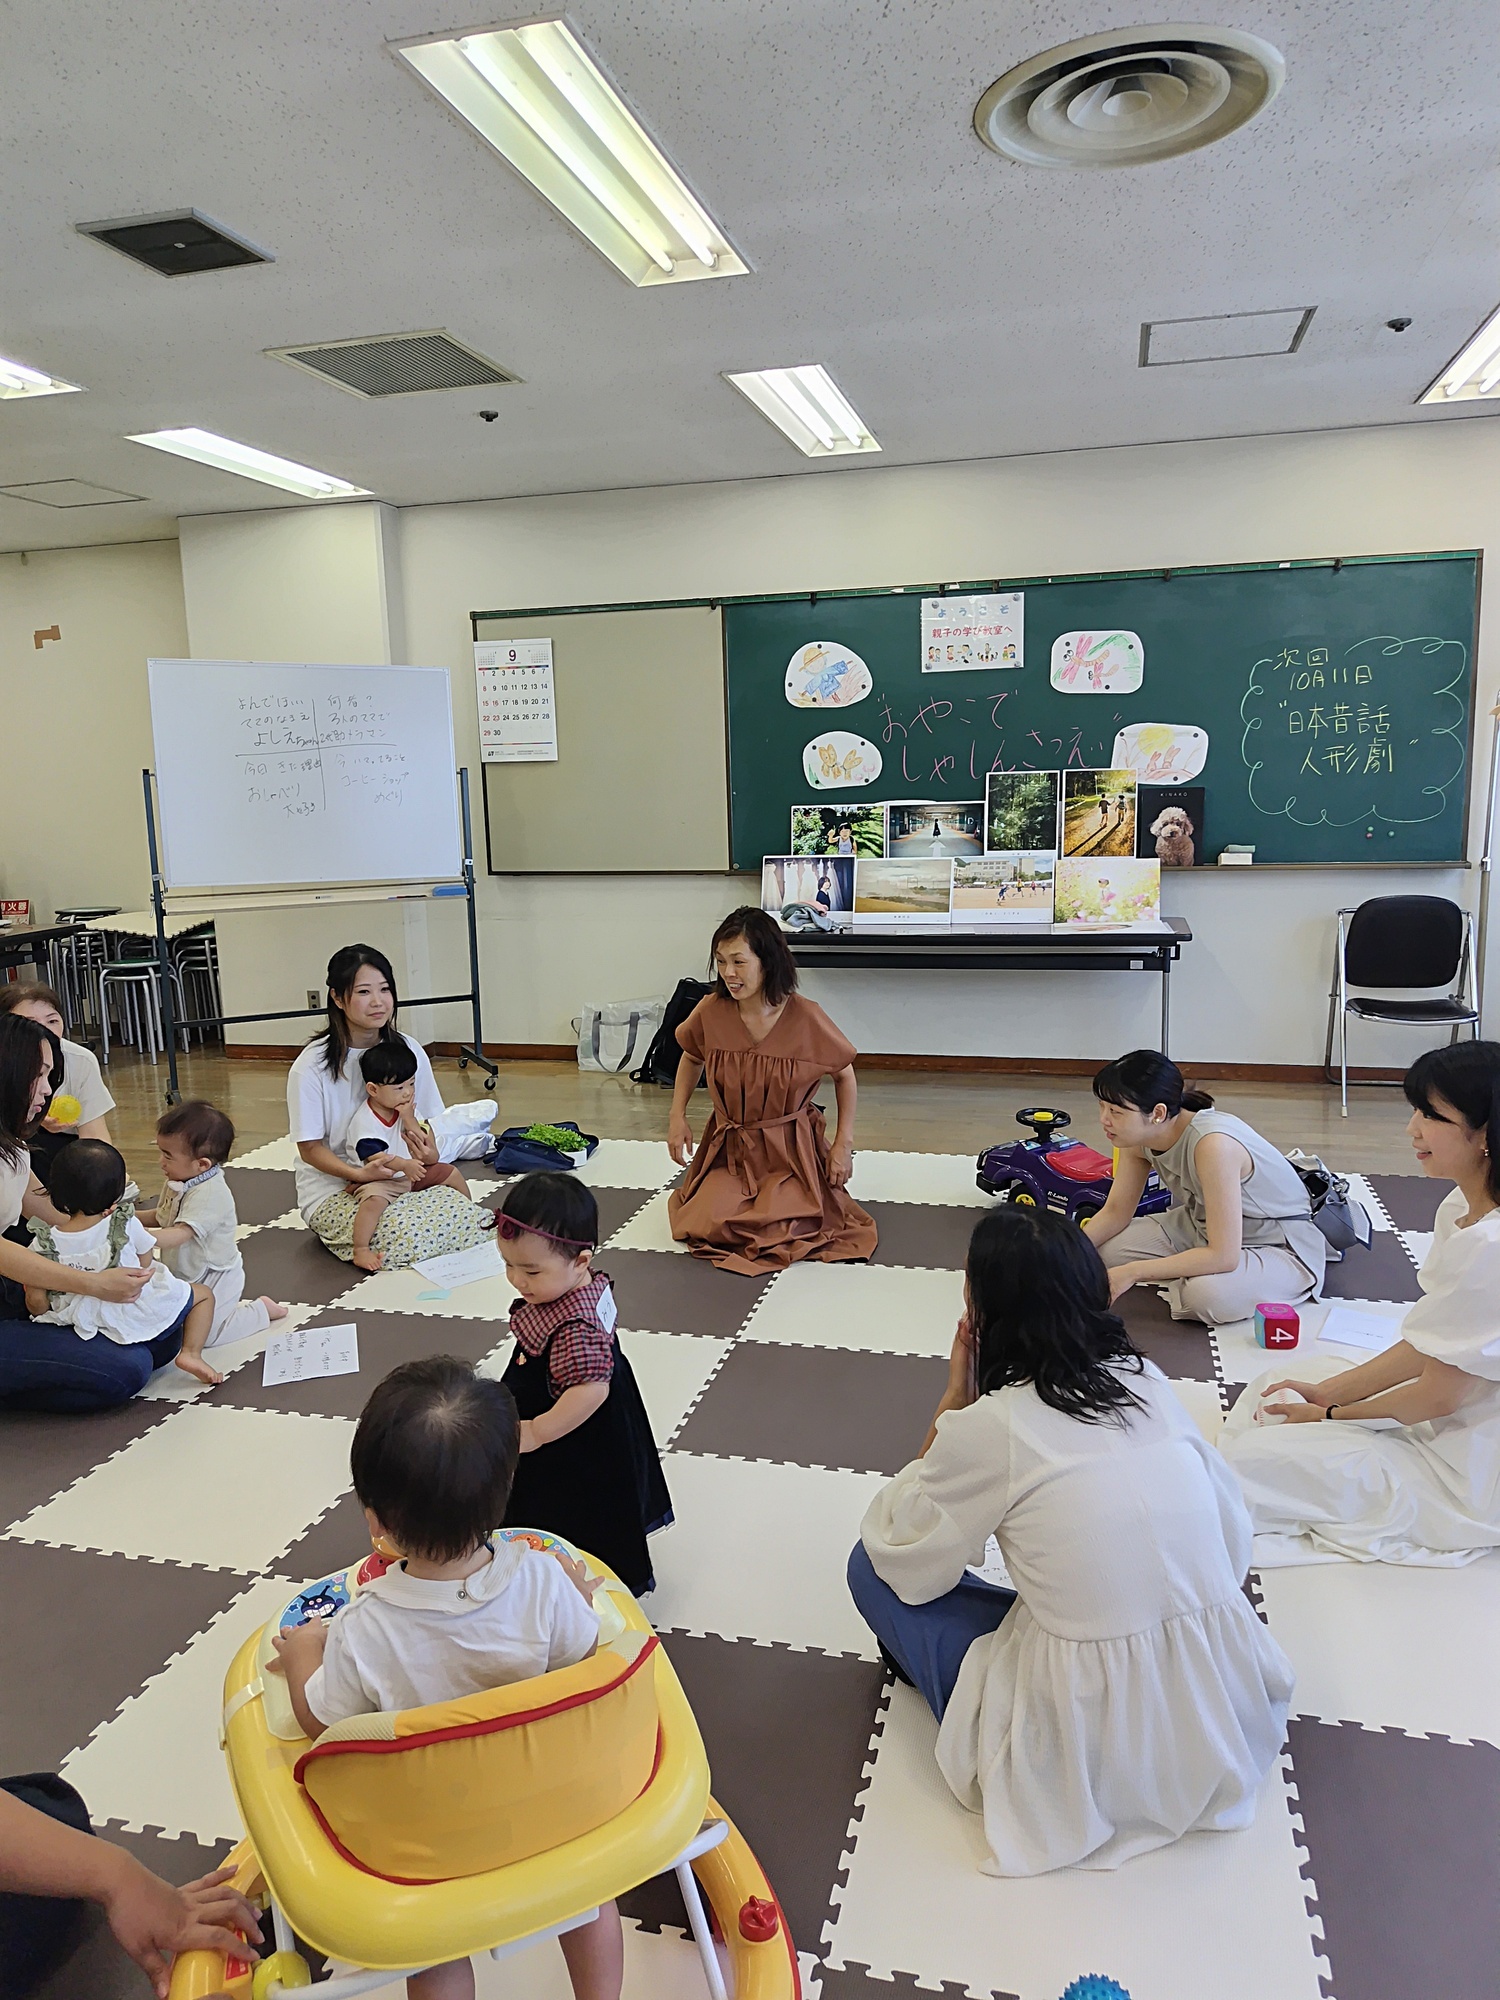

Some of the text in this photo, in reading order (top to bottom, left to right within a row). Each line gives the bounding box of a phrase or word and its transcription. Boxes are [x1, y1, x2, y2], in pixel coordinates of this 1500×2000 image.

[937, 604, 1010, 618] ようこそ
[931, 625, 1013, 639] 親子の学び教室へ
[508, 649, 517, 662] 9
[1273, 648, 1328, 670] 次回
[1290, 665, 1372, 690] 10月11日
[1270, 1327, 1294, 1343] 4
